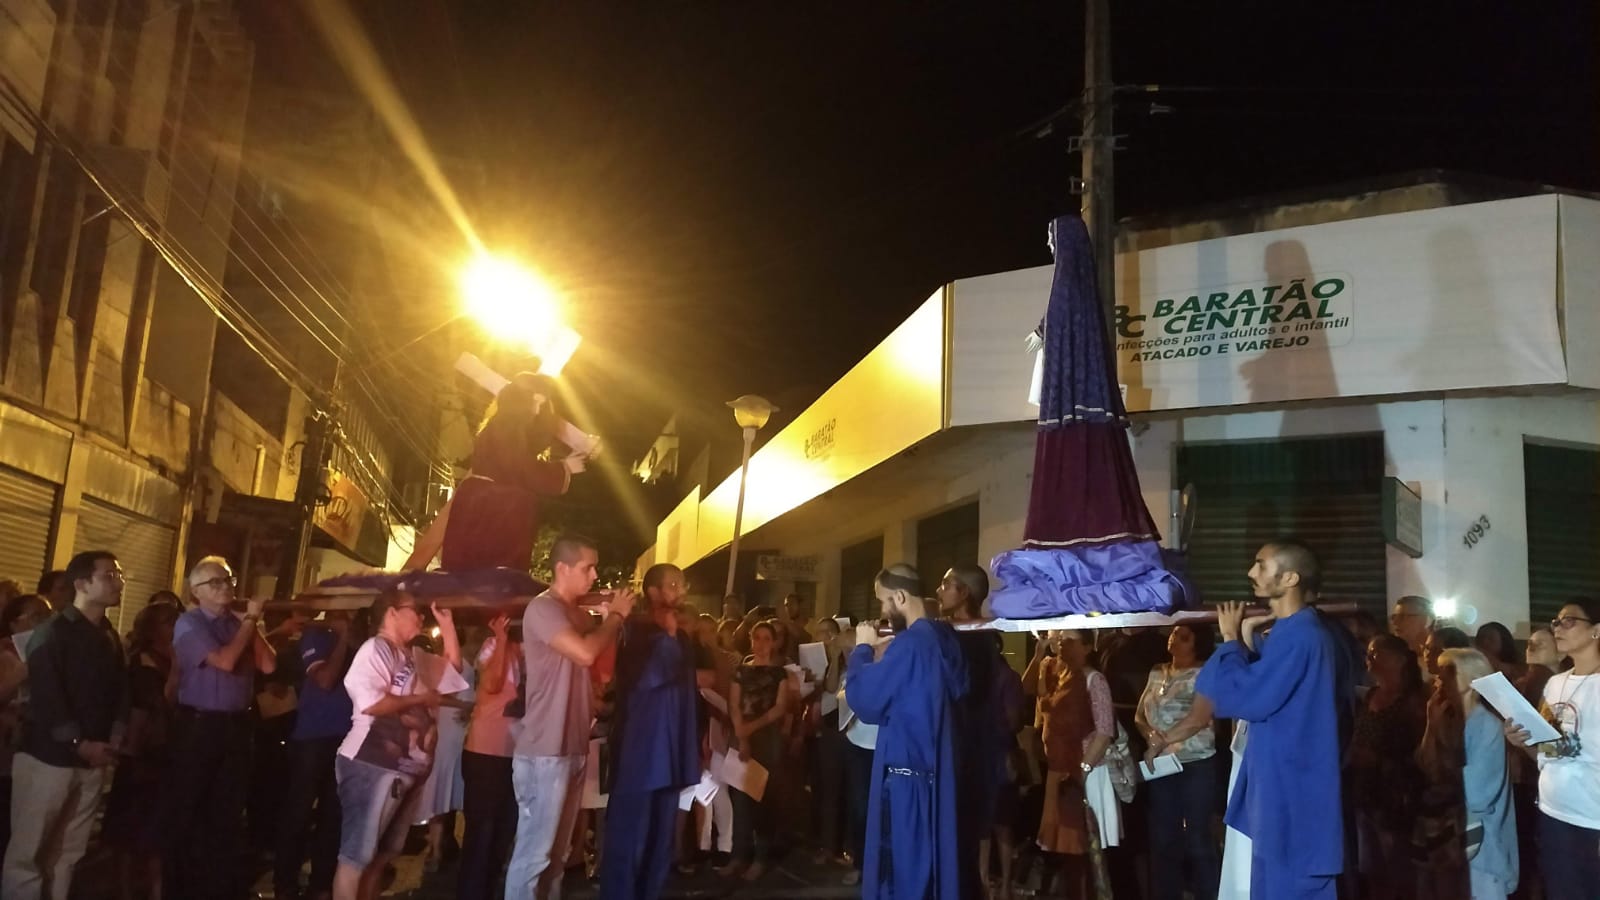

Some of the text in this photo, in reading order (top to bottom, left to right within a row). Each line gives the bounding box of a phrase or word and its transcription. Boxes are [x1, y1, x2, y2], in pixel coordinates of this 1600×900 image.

[1153, 279, 1344, 318] BARATÃO
[1117, 317, 1349, 351] nfecções para adultos e infantil
[1164, 300, 1334, 334] CENTRAL
[1130, 335, 1309, 363] ATACADO E VAREJO
[1463, 514, 1491, 549] 1093
